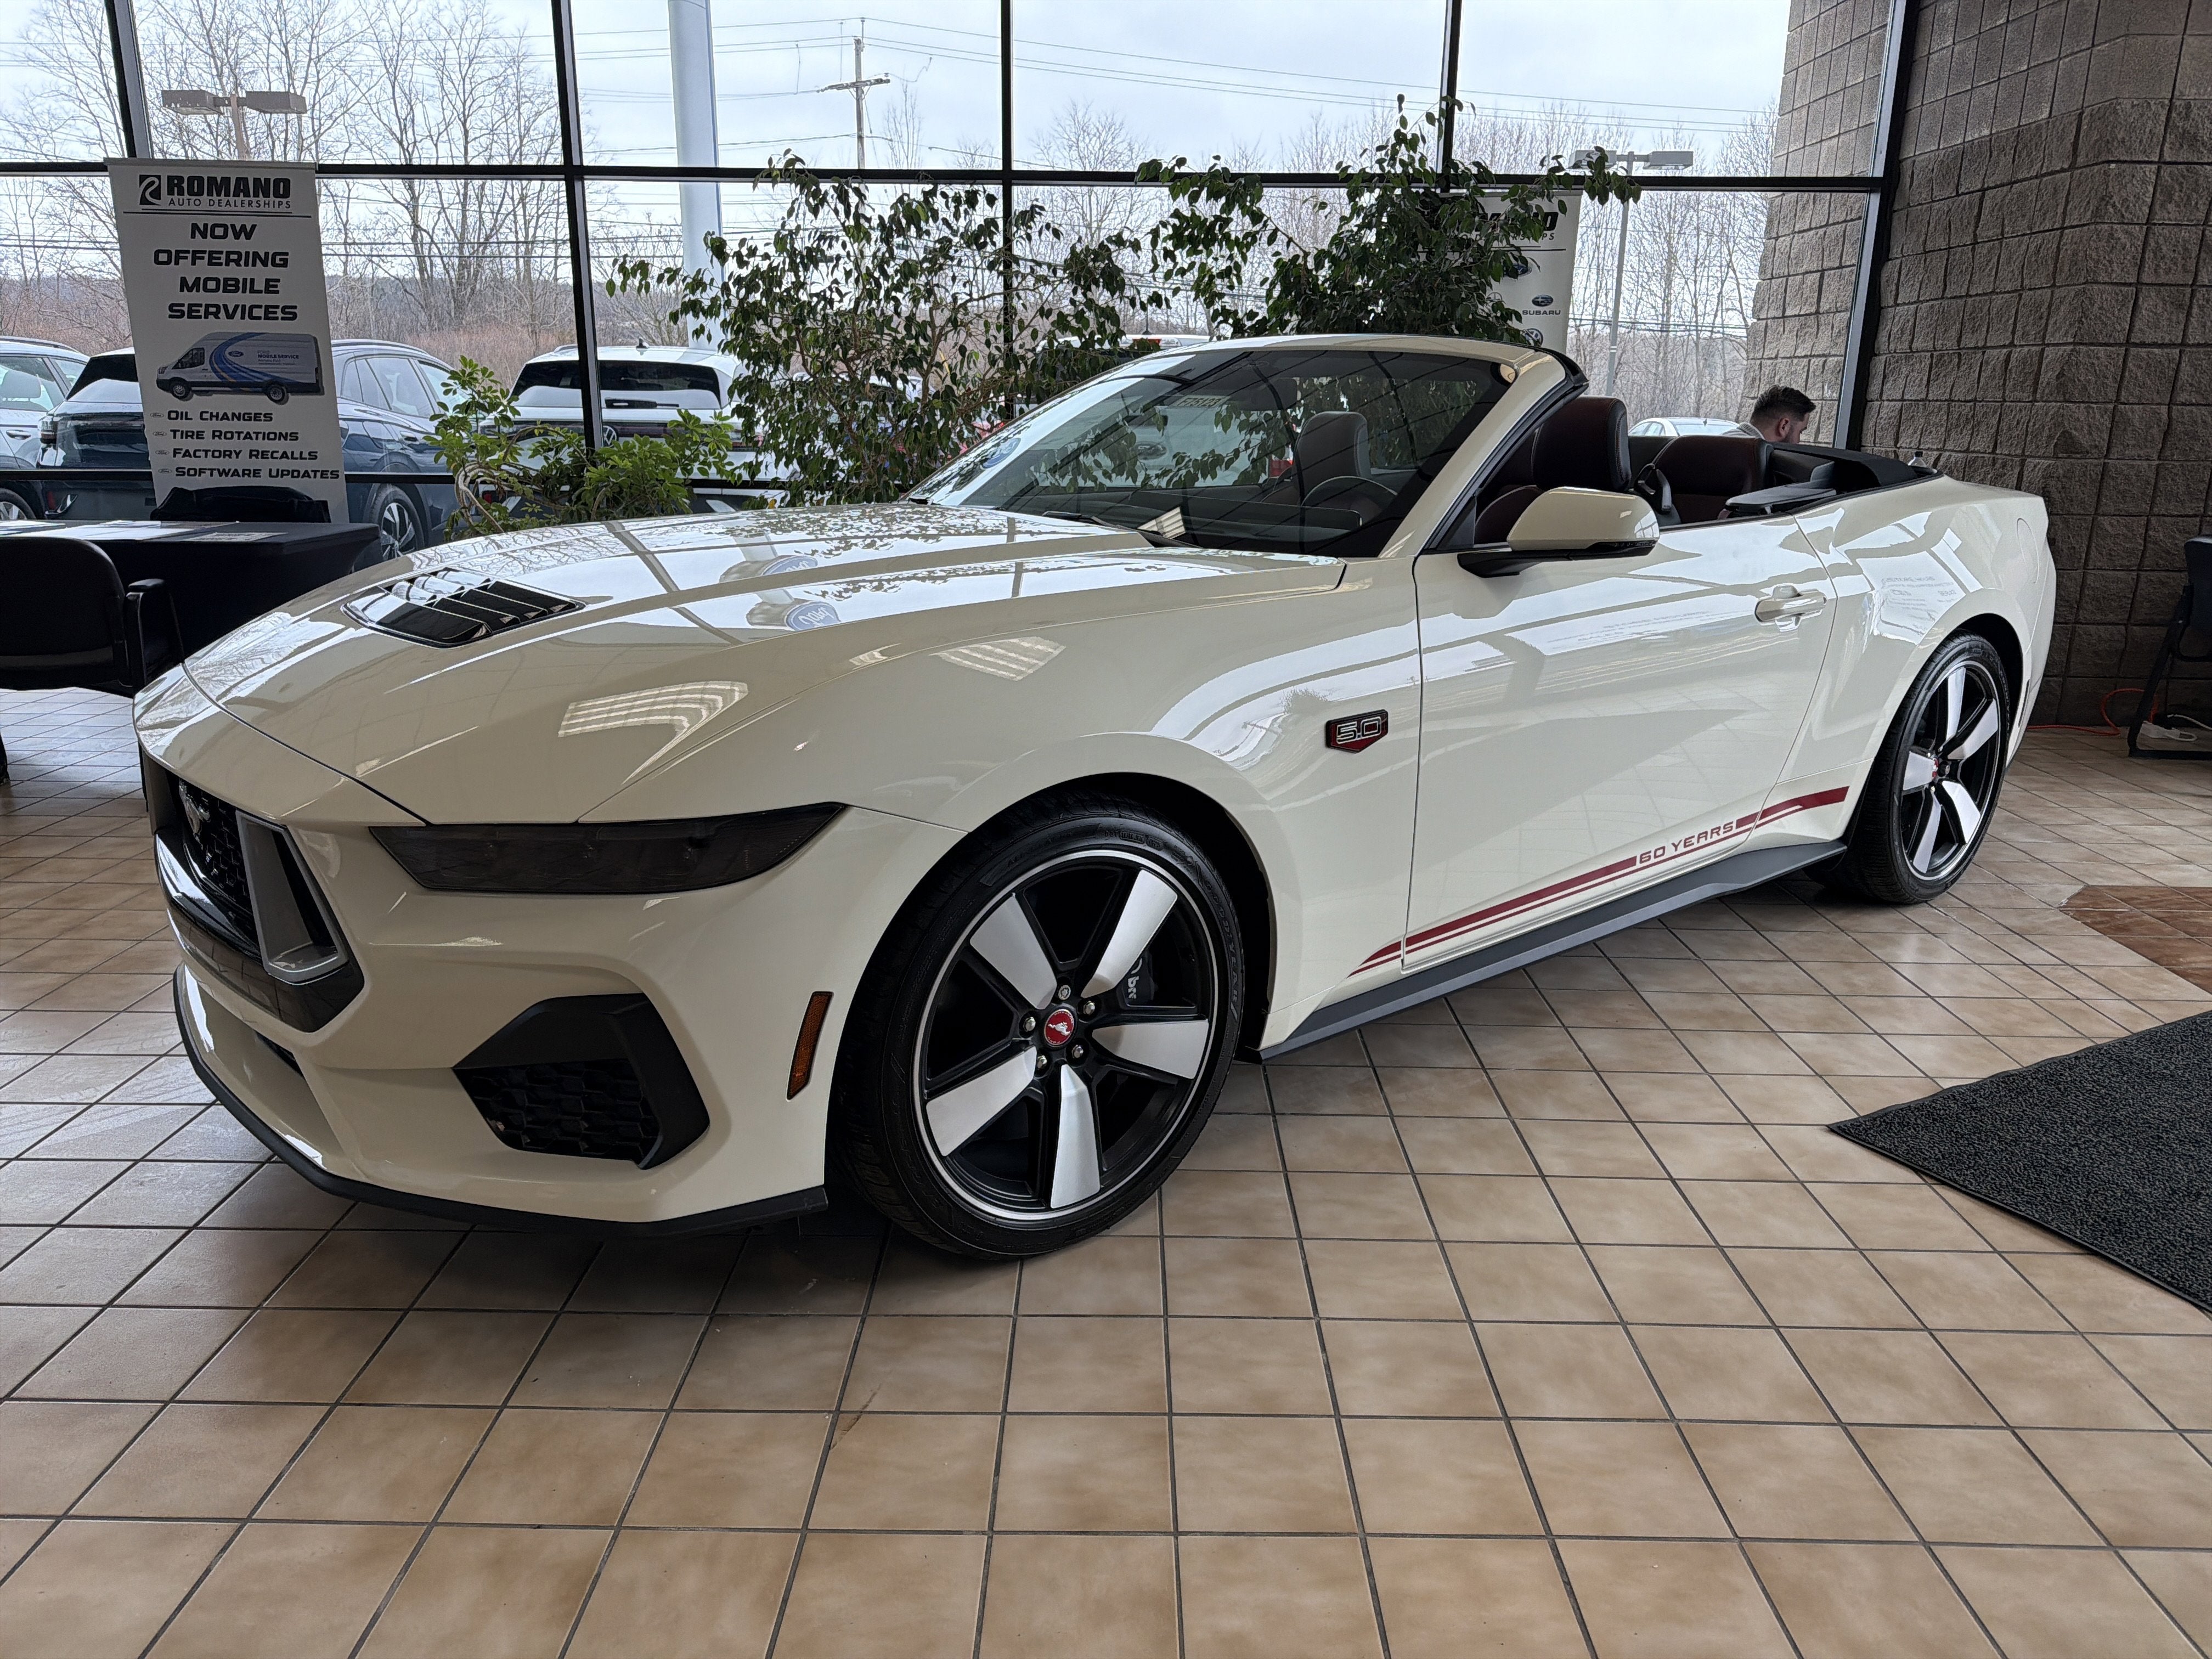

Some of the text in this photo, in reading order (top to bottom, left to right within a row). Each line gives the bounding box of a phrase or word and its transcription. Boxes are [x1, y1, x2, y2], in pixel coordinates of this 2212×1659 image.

[167, 174, 291, 199] ROMANO
[168, 198, 291, 209] AUTO DEALERSHIPS
[190, 223, 257, 240] NOW
[154, 249, 289, 268] OFFERING
[179, 276, 281, 295] MOBILE
[168, 302, 298, 321] SERVICES
[1177, 397, 1222, 407] F75123
[167, 410, 273, 422] OIL CHANGES
[170, 429, 299, 442] TIRE ROTATIONS
[172, 448, 318, 461] FACTORY RECALLS
[175, 466, 340, 479] SOFTWARE UPDATES
[1336, 715, 1382, 745] 5.0
[1639, 821, 1734, 865] 60 YEARS
